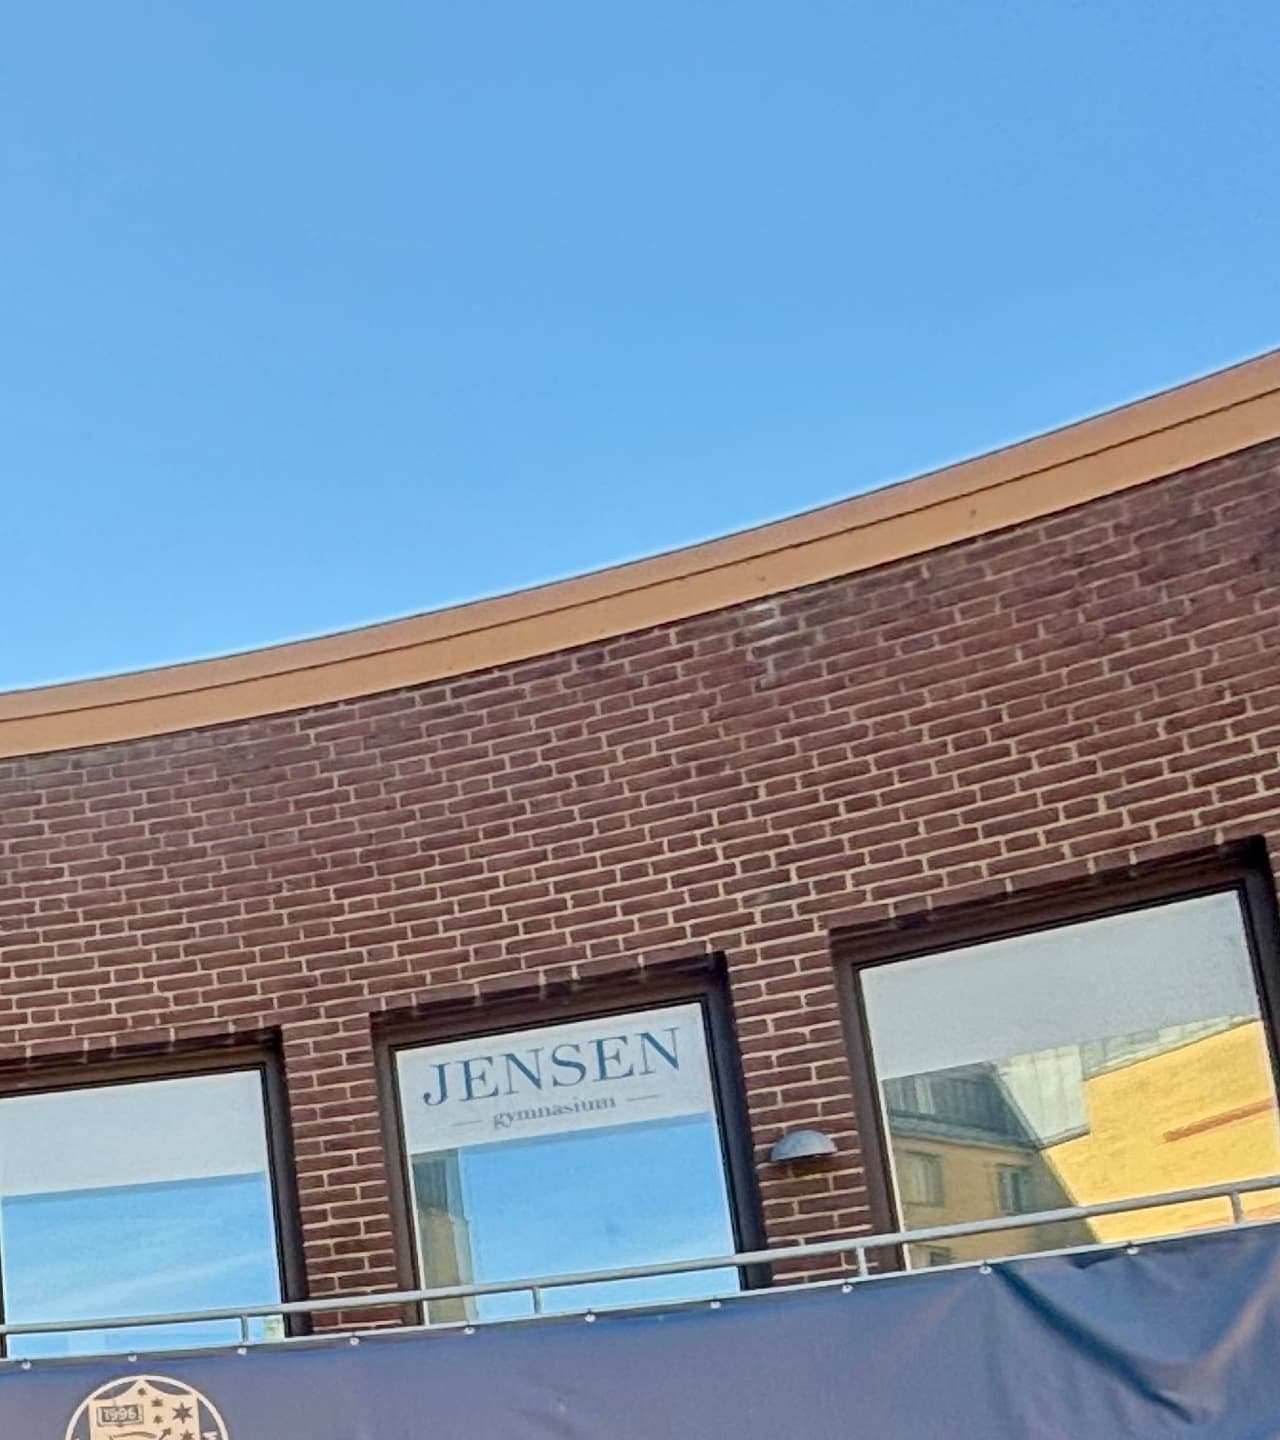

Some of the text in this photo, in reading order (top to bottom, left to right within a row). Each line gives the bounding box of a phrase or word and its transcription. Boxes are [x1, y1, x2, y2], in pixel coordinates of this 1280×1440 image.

[422, 1027, 681, 1106] JENSEN
[492, 1096, 617, 1129] gymnasium
[103, 1406, 137, 1422] 1996
